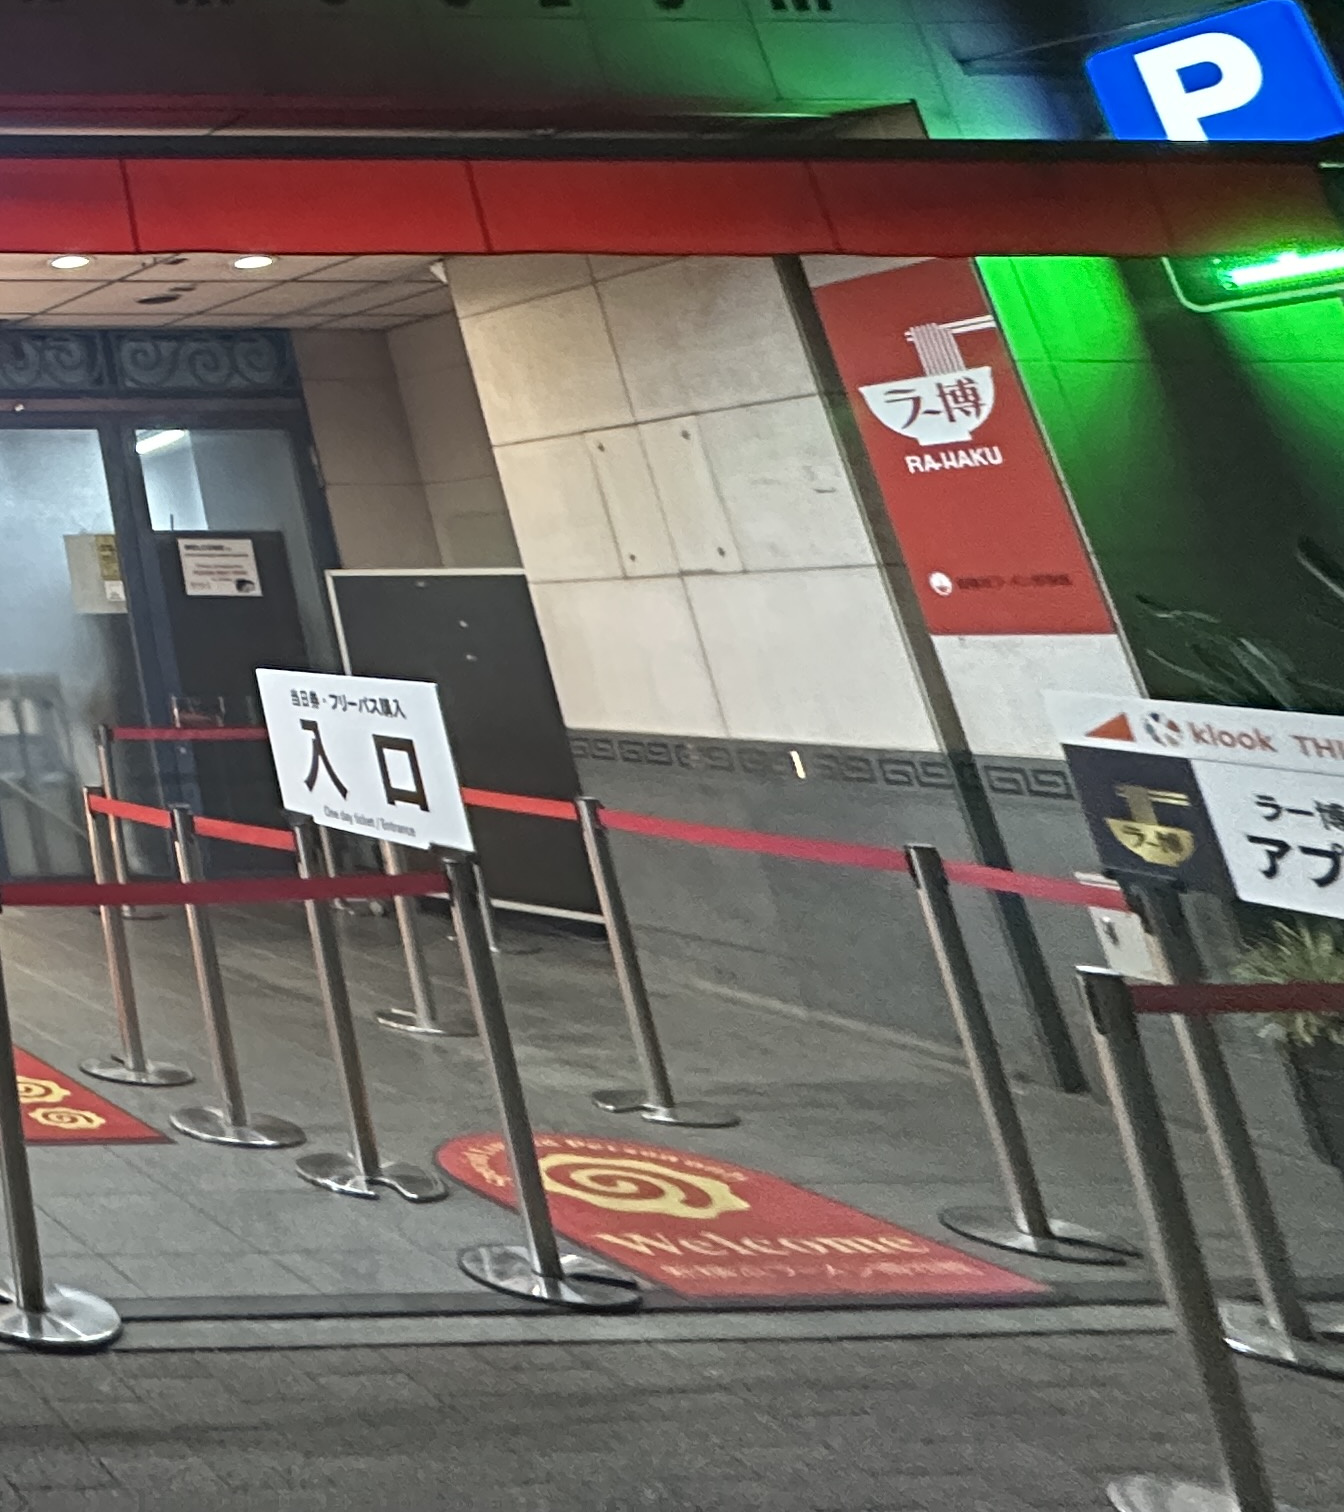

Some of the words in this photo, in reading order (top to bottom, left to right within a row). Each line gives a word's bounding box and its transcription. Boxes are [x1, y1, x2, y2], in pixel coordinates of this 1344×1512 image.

[1130, 29, 1264, 141] P
[883, 376, 986, 430] ラー博
[904, 446, 1003, 474] RA-HAKU
[1186, 721, 1278, 753] klook
[299, 718, 430, 812] 入口
[596, 1231, 930, 1257] Welcome
